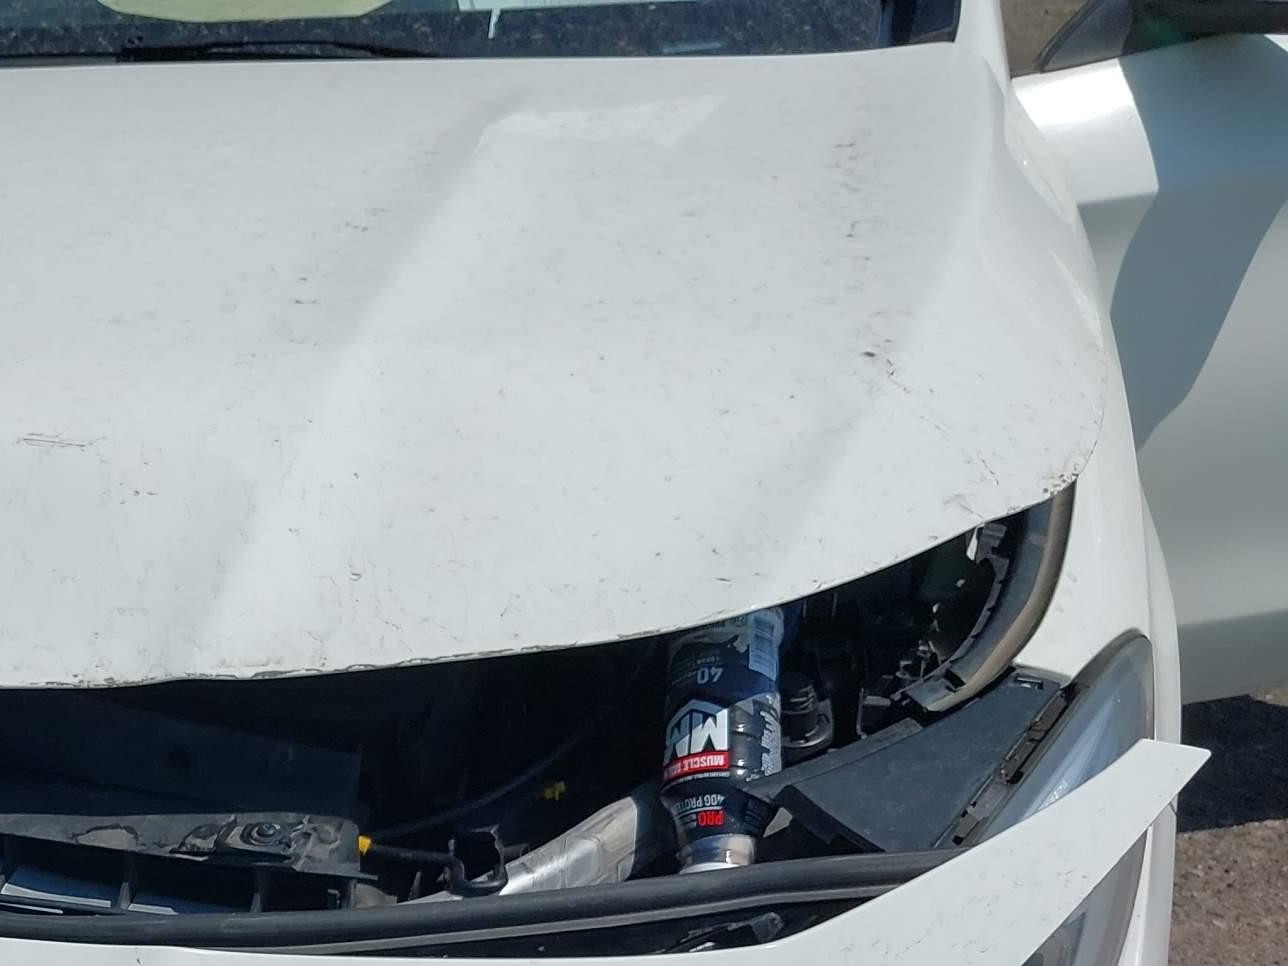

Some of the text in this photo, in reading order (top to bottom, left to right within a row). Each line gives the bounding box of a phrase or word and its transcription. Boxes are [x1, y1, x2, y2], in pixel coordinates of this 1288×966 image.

[697, 666, 723, 685] 40
[682, 754, 725, 771] MUSCLE
[703, 793, 726, 806] 40G
[697, 810, 725, 827] PRO
